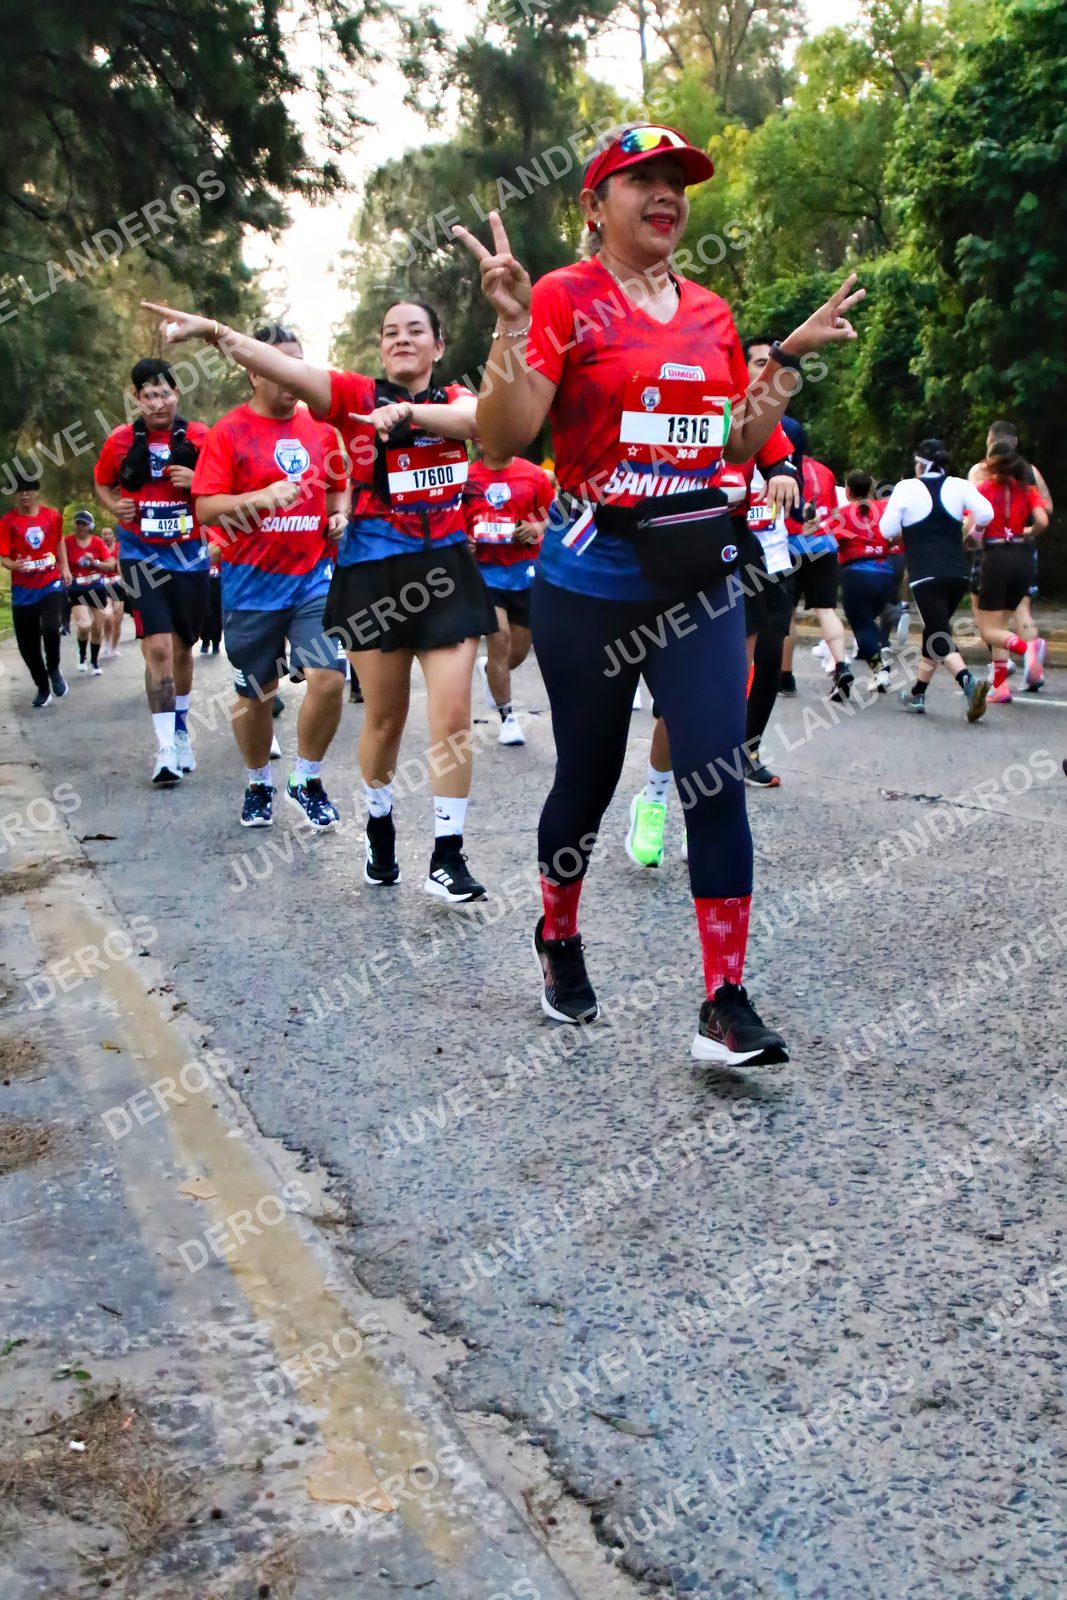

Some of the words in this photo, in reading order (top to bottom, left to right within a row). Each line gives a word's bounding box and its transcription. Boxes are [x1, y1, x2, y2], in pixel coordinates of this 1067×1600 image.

[668, 416, 709, 443] 1316
[413, 466, 454, 488] 17600
[604, 467, 710, 497] SANTI
[158, 519, 178, 530] 4124
